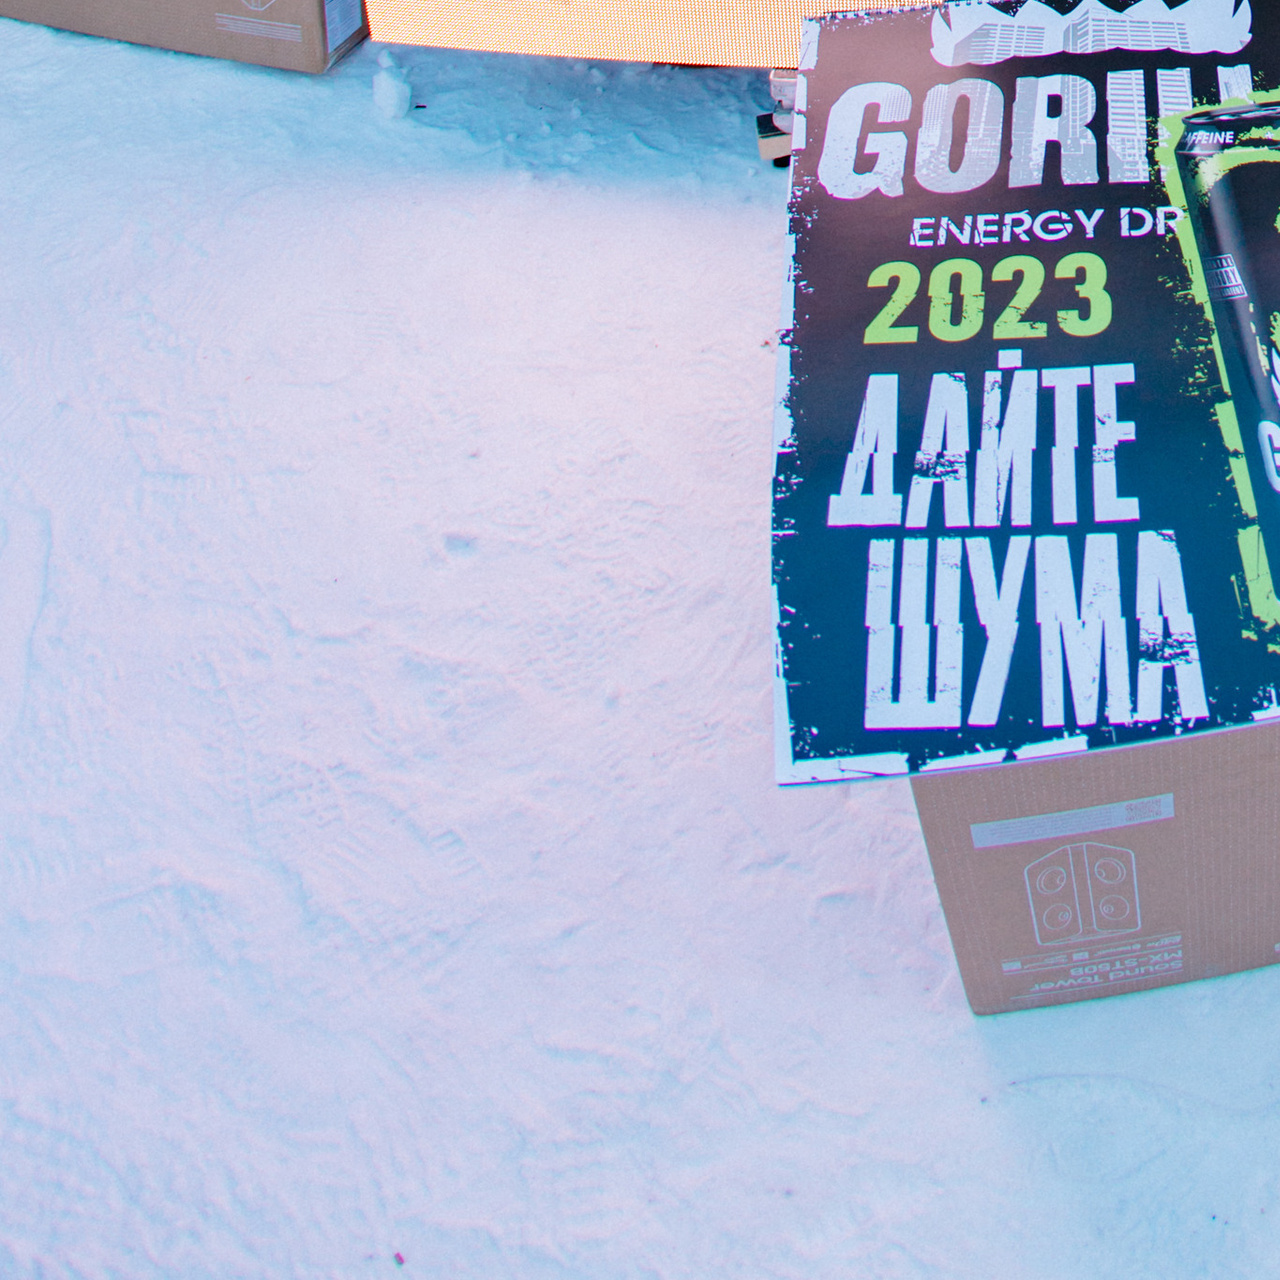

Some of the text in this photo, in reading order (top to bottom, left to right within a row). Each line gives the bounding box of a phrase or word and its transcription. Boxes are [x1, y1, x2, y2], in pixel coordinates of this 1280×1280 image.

[909, 208, 1104, 248] ENERGY
[863, 251, 1113, 345] 2023
[826, 349, 1140, 529] ДАЙТЕ
[864, 530, 1209, 730] ШУМА
[1029, 959, 1184, 992] Sound Tower
